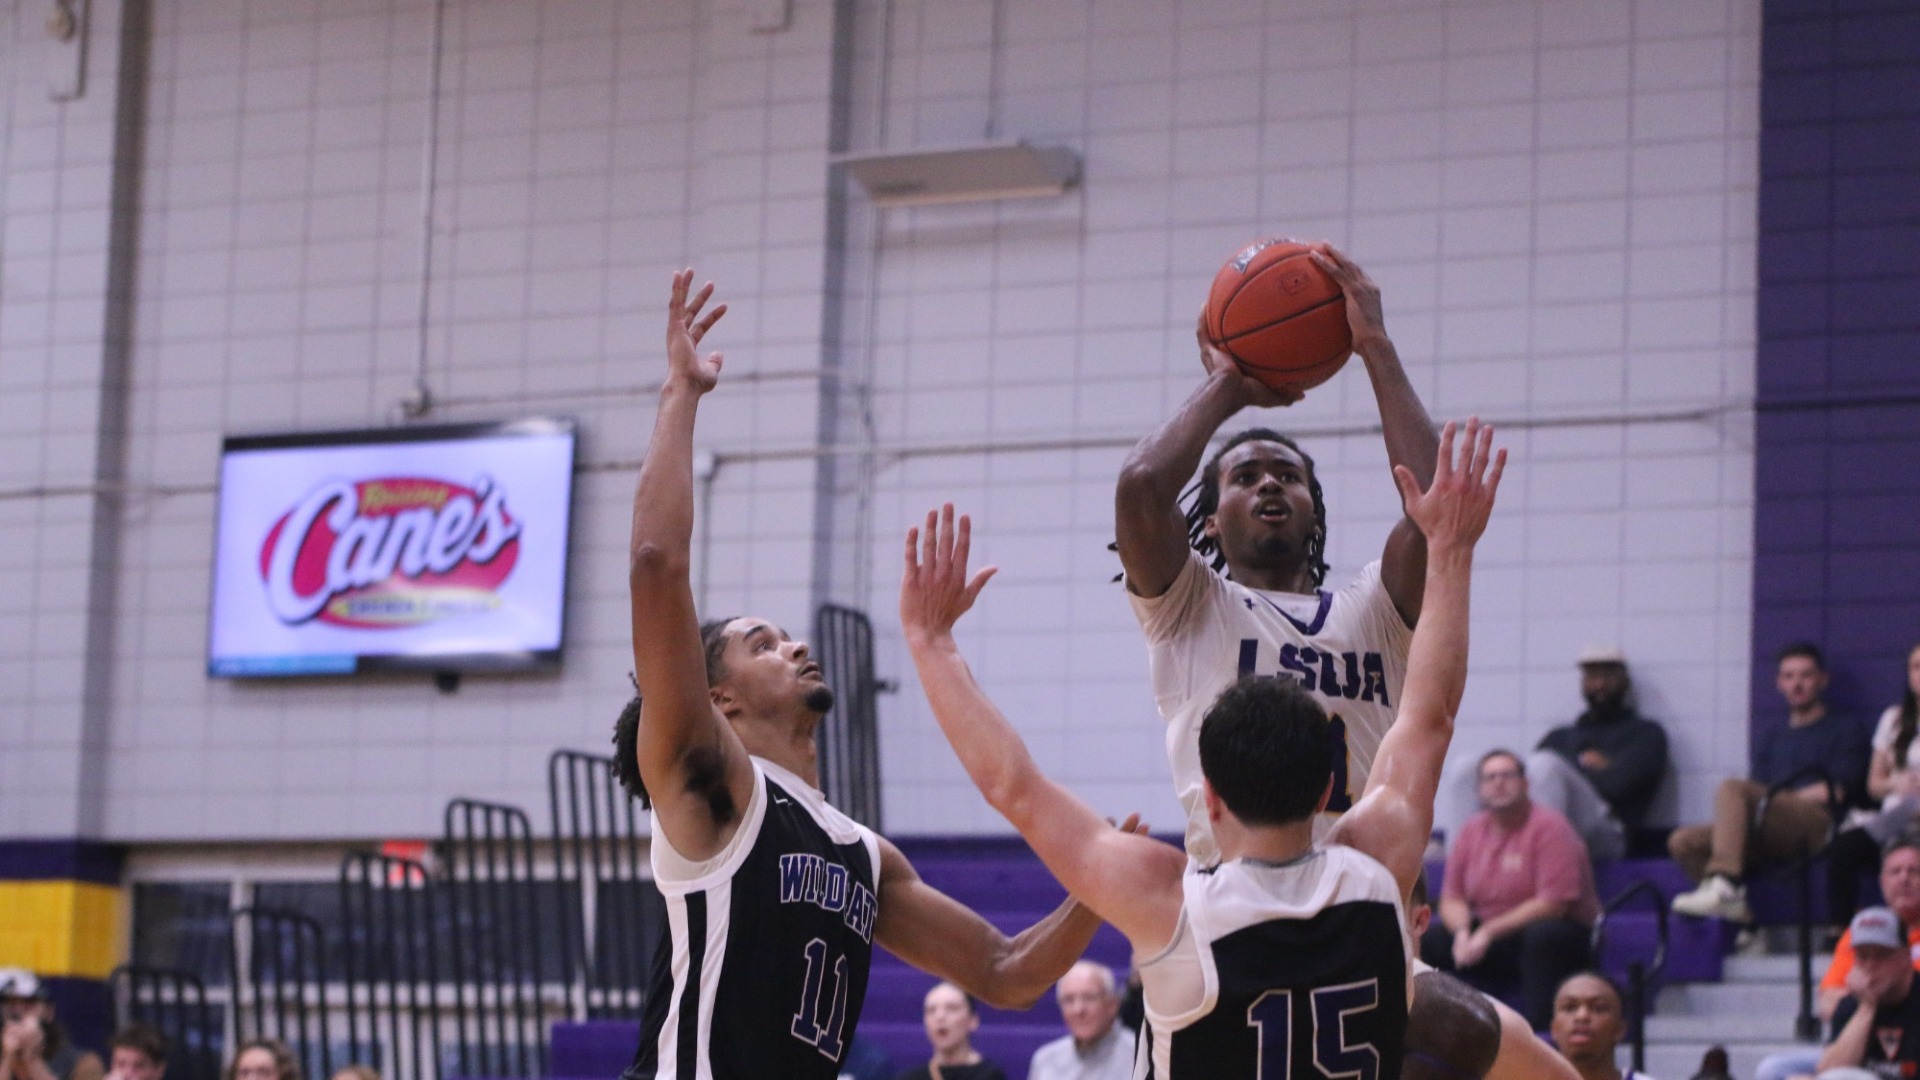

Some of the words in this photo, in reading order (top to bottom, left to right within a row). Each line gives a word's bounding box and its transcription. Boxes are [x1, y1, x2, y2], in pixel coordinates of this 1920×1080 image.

[267, 475, 522, 625] Cane's
[1237, 639, 1391, 708] LSUA
[779, 853, 878, 945] WILDAT
[791, 937, 848, 1063] 11
[1247, 977, 1380, 1080] 15
